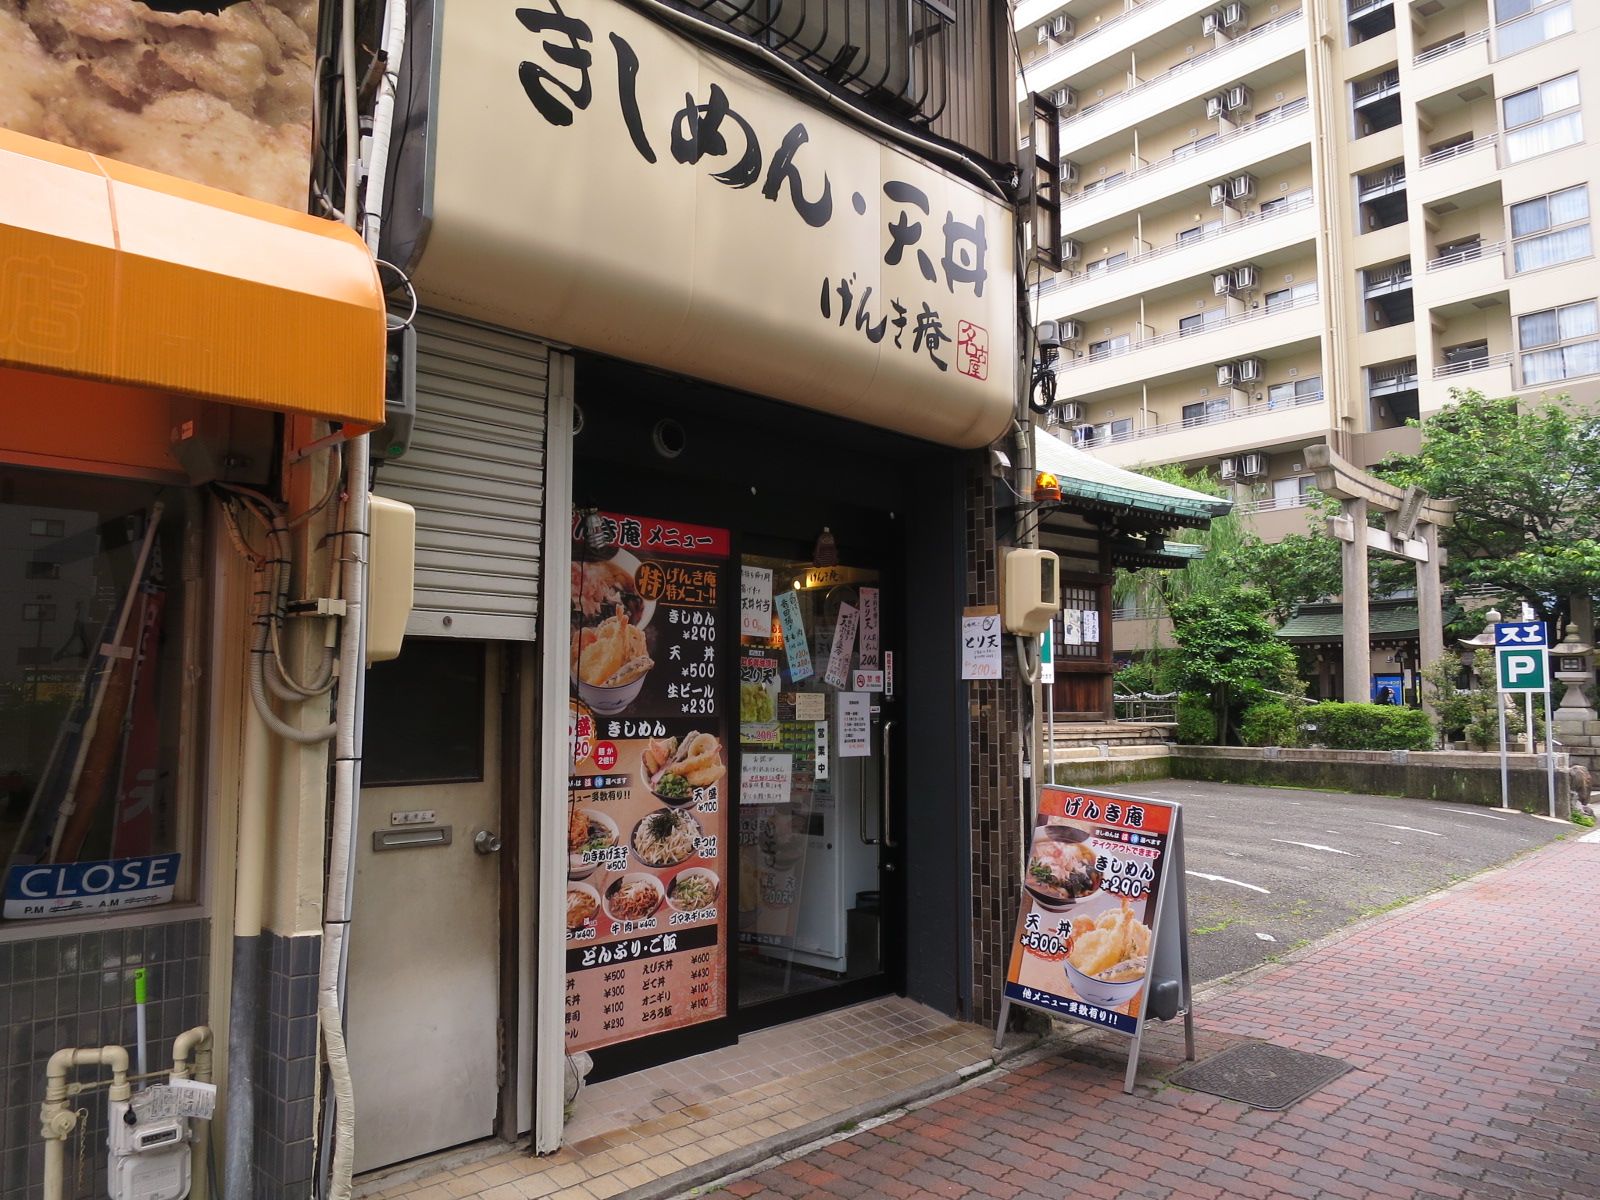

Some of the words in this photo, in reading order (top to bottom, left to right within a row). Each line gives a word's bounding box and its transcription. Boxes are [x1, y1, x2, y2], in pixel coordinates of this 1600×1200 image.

[820, 272, 952, 371] げんき庵
[648, 524, 713, 548] メニュー
[666, 567, 717, 587] げんき庵
[668, 609, 715, 627] きしめん
[682, 625, 716, 642] ¥290
[965, 634, 999, 649] とり天
[1499, 624, 1542, 644] スエ
[681, 663, 715, 678] ¥500
[1507, 655, 1536, 683] P
[667, 683, 715, 699] 生ビール
[681, 699, 715, 714] ¥230
[607, 720, 666, 738] きしめん
[817, 728, 826, 774] 営業中
[698, 801, 717, 811] ¥700
[1065, 796, 1144, 827] げんき庵
[1092, 839, 1160, 859] テイクアウトできます
[606, 860, 626, 870] ¥500
[1095, 855, 1154, 881] きしめん
[20, 858, 170, 898] CLOSE
[611, 921, 633, 934] 牛肉
[582, 933, 677, 966] どんぶり・ご飯
[643, 959, 673, 975] えび天丼
[691, 953, 710, 964] ¥600
[604, 969, 625, 982] ¥500
[642, 977, 666, 990] どて丼
[642, 991, 671, 1006] オニギリ
[691, 982, 709, 994] ¥100
[603, 1001, 624, 1014] ¥100
[642, 1006, 672, 1021] とろろ飯
[1022, 986, 1118, 1026] 他メニュー多数有り!!
